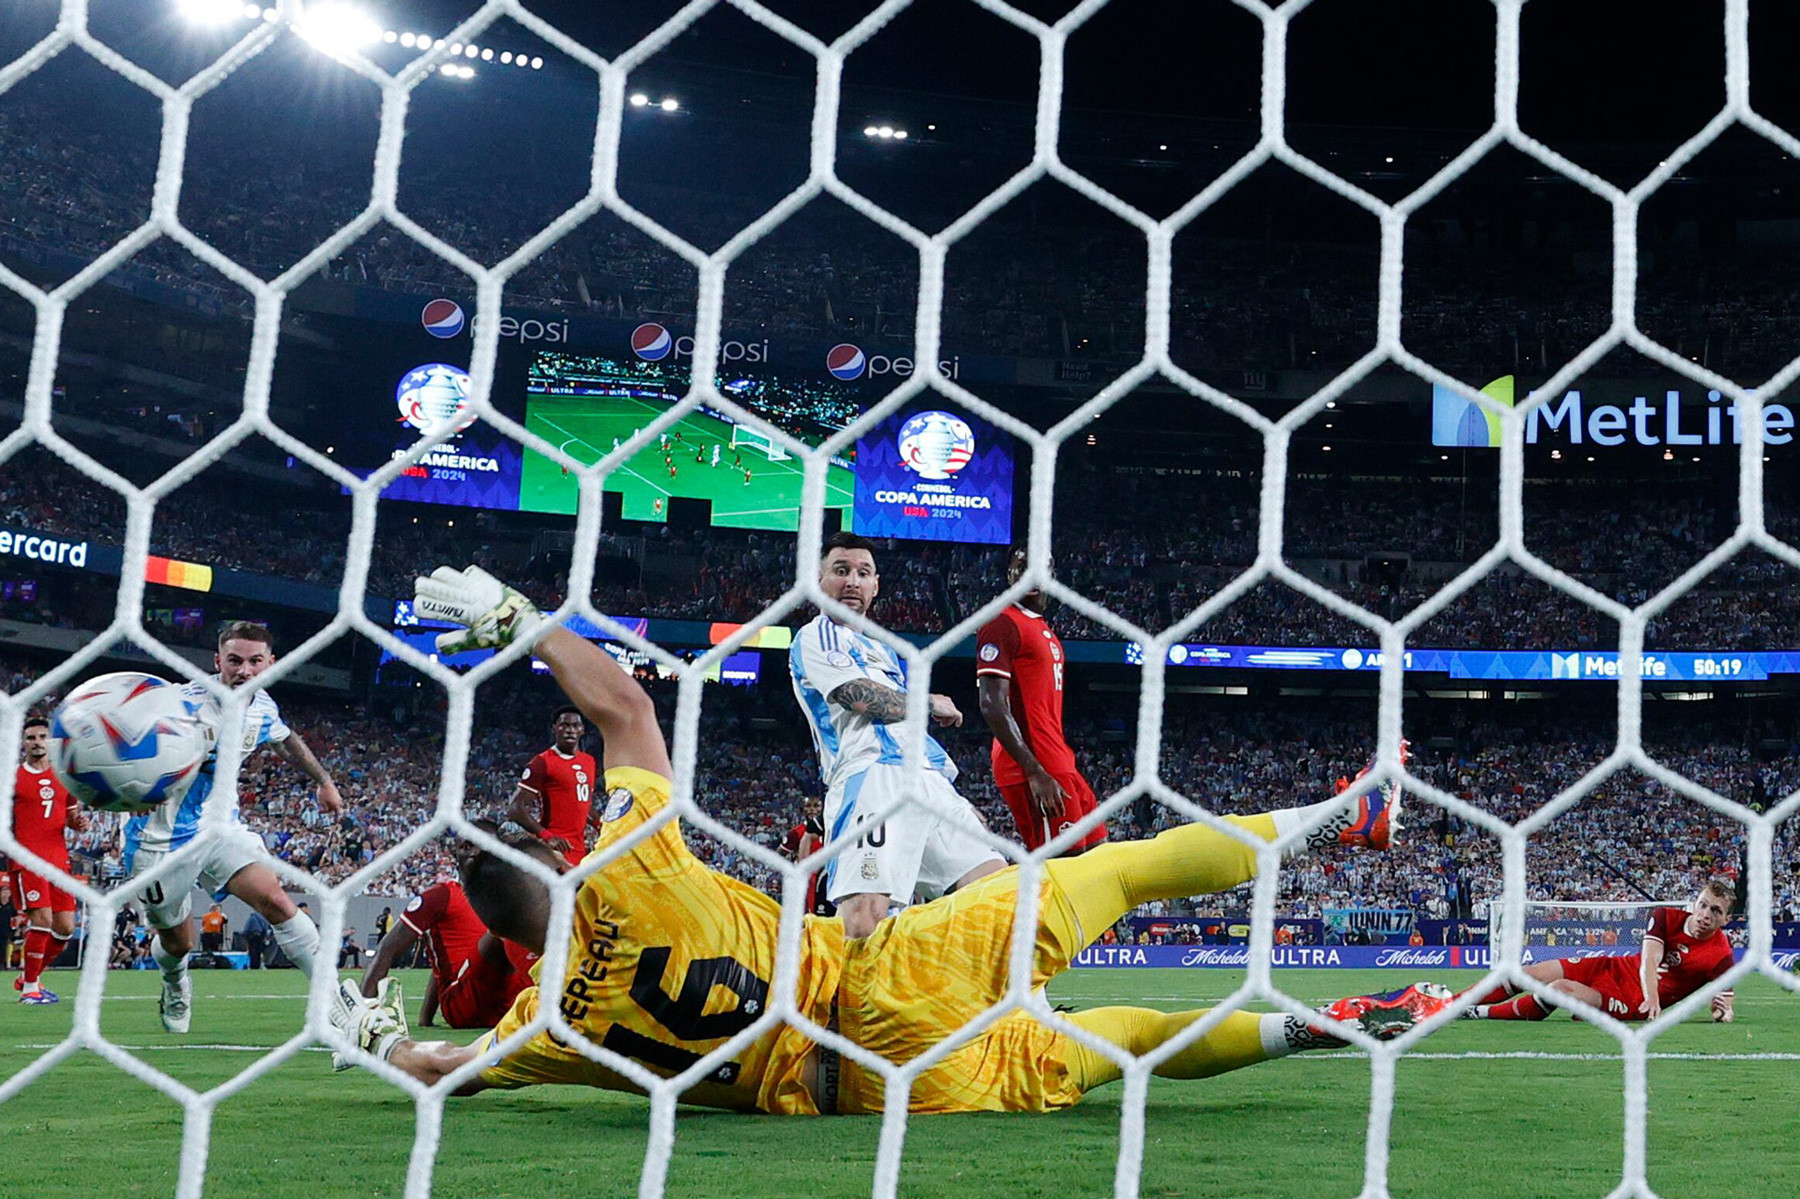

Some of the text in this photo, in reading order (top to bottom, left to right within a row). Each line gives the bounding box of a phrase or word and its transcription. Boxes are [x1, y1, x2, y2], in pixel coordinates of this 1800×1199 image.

[674, 336, 768, 365] ppsi
[868, 355, 959, 379] pesi
[1526, 389, 1794, 446] MetLife
[420, 453, 499, 472] AMERICA
[432, 468, 466, 481] 2024
[875, 490, 991, 509] COPA AMERICA
[903, 506, 962, 519] USA 2024
[0, 531, 87, 568] ercard
[1366, 652, 1412, 668] AR 1
[1585, 656, 1742, 676] Metife 50:19
[577, 784, 589, 802] 10
[41, 800, 53, 819] 7
[857, 813, 886, 849] 10
[1395, 912, 1412, 932] 77
[1077, 948, 1147, 965] ULTRA
[1181, 948, 1341, 967] Michelob ULTRA
[1375, 948, 1533, 967] Michelob ULA
[546, 918, 619, 1048] EPEAU
[602, 946, 770, 1085] 16
